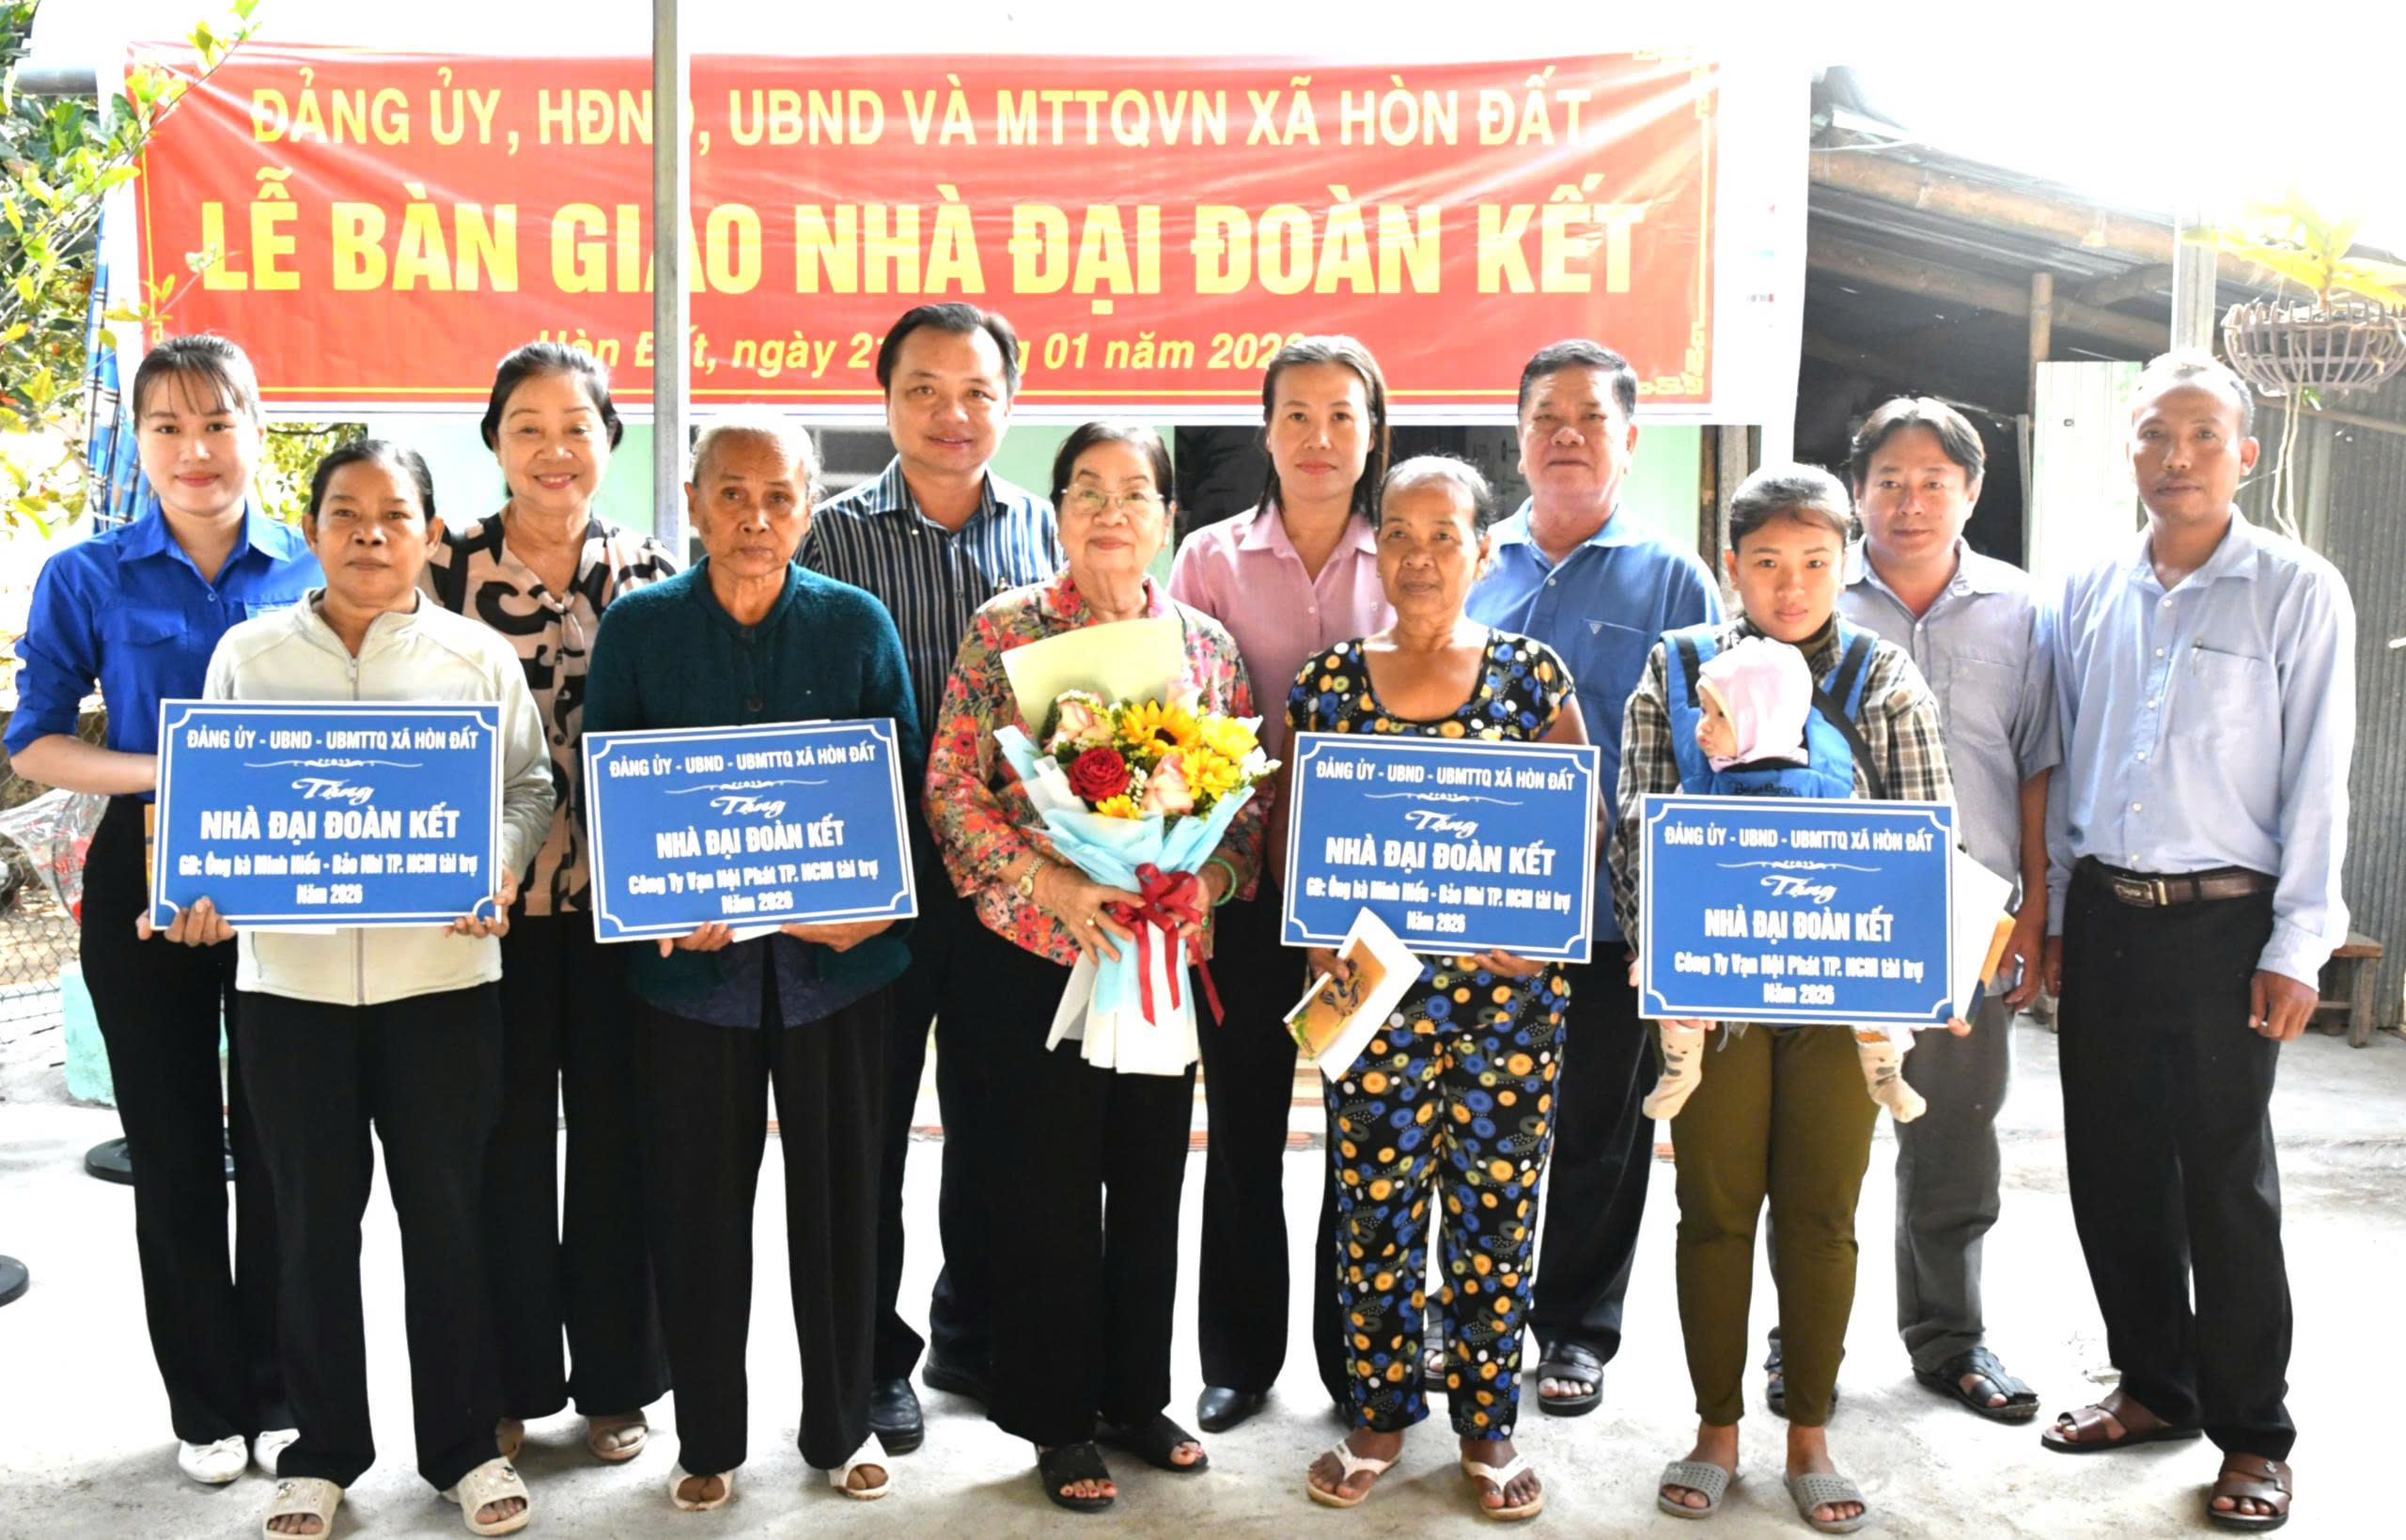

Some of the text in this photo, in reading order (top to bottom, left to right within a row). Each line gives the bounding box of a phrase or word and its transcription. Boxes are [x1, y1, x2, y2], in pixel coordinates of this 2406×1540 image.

[251, 65, 1591, 157] ĐẢNG ỦY, HĐN, UBND VÀ MTTQVN XÃ HÒN ĐẤT
[200, 166, 302, 291] LỄ
[330, 181, 519, 293] BÀN
[795, 183, 986, 294] NHÀ
[1007, 202, 1161, 316] ĐẠI
[1190, 184, 1441, 295] ĐOÀN
[1476, 173, 1646, 295] KẾT
[731, 330, 837, 379] ngày
[848, 332, 885, 368] 2
[1044, 332, 1089, 369] 01
[1104, 331, 1195, 370] năm
[1206, 332, 1305, 370] 202
[187, 725, 229, 748] ĐẢNG
[235, 725, 256, 748] ỦY
[271, 731, 312, 749] UBND
[326, 731, 387, 750] UBMTTQ
[391, 728, 411, 749] XÃ
[414, 728, 445, 749] HÒN
[449, 726, 478, 749] ĐẤT
[610, 756, 649, 777] ĐẢNG
[653, 754, 672, 775] ỦY
[685, 755, 724, 773] UBND
[737, 751, 793, 770] UBMTTQ
[796, 747, 815, 766] XÃ
[818, 745, 846, 764] HÒN
[850, 740, 875, 762] ĐẤT
[1317, 756, 1353, 779] ĐẢNG
[1357, 759, 1375, 780] ỦY
[1387, 765, 1424, 783] UBND
[1437, 767, 1492, 786] UBMTTQ
[1494, 767, 1512, 787] XÃ
[1516, 768, 1544, 789] HÒN
[1548, 768, 1575, 790] ĐẤT
[292, 778, 374, 805] Tặng
[711, 797, 786, 818] Tặng
[201, 802, 460, 845] NHÀ ĐẠI ĐOÀN KẾT
[657, 814, 844, 860] NHÀ ĐẠI ĐOÀN KẾT
[1406, 811, 1477, 838] Tặng
[1664, 822, 1703, 845] ĐẢNG
[1707, 822, 1726, 846] ỦY
[1740, 829, 1777, 847] UBND
[1791, 831, 1848, 849] UBMTTQ
[1851, 829, 1869, 849] XÃ
[1873, 829, 1902, 850] HÒN
[1905, 828, 1933, 851] ĐẤT
[1325, 834, 1555, 876] NHÀ ĐẠI ĐOÀN KẾT
[1761, 875, 1836, 904] Tặng
[1705, 904, 1893, 944] NHÀ ĐẠI ĐOÀN KẾT
